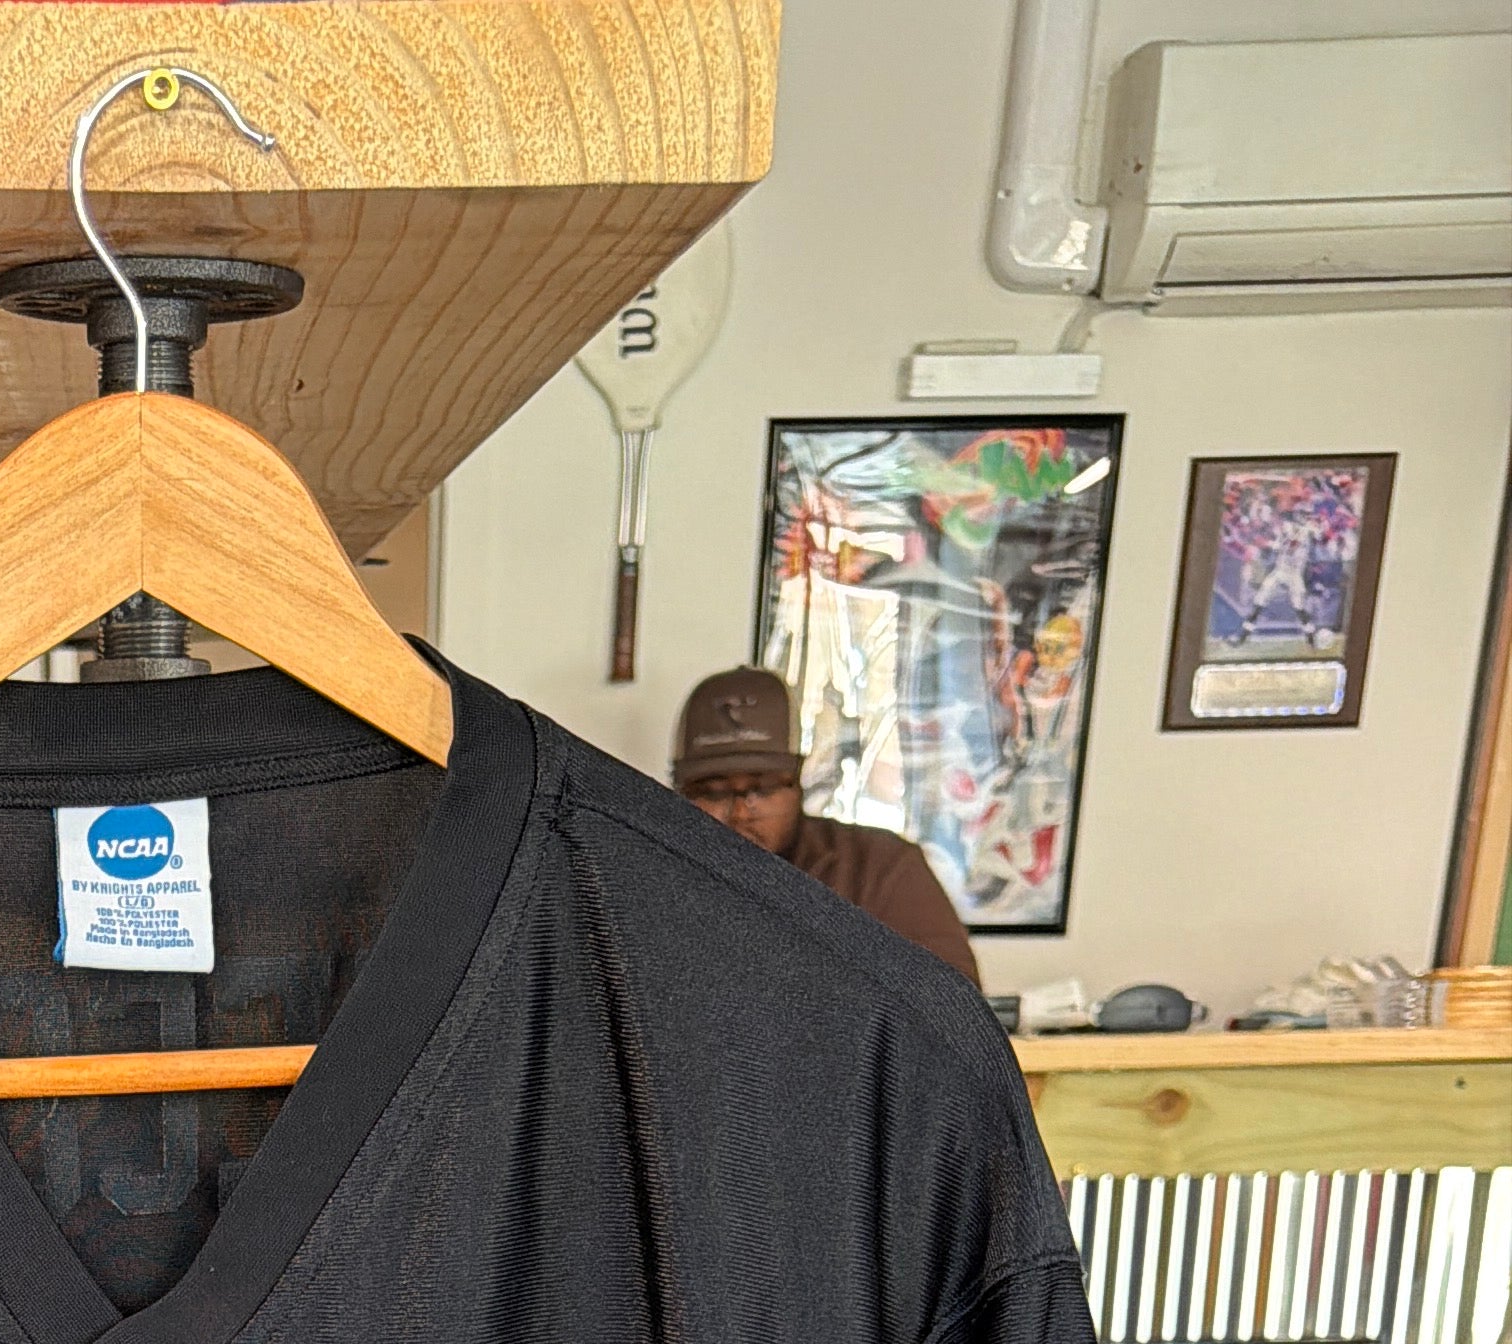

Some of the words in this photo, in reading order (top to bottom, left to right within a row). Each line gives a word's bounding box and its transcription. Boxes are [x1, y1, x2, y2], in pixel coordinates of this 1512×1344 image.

[96, 837, 169, 858] NCAA
[72, 880, 88, 893] BY
[90, 881, 143, 896] KNIGHTS
[146, 880, 201, 894] APPAREL
